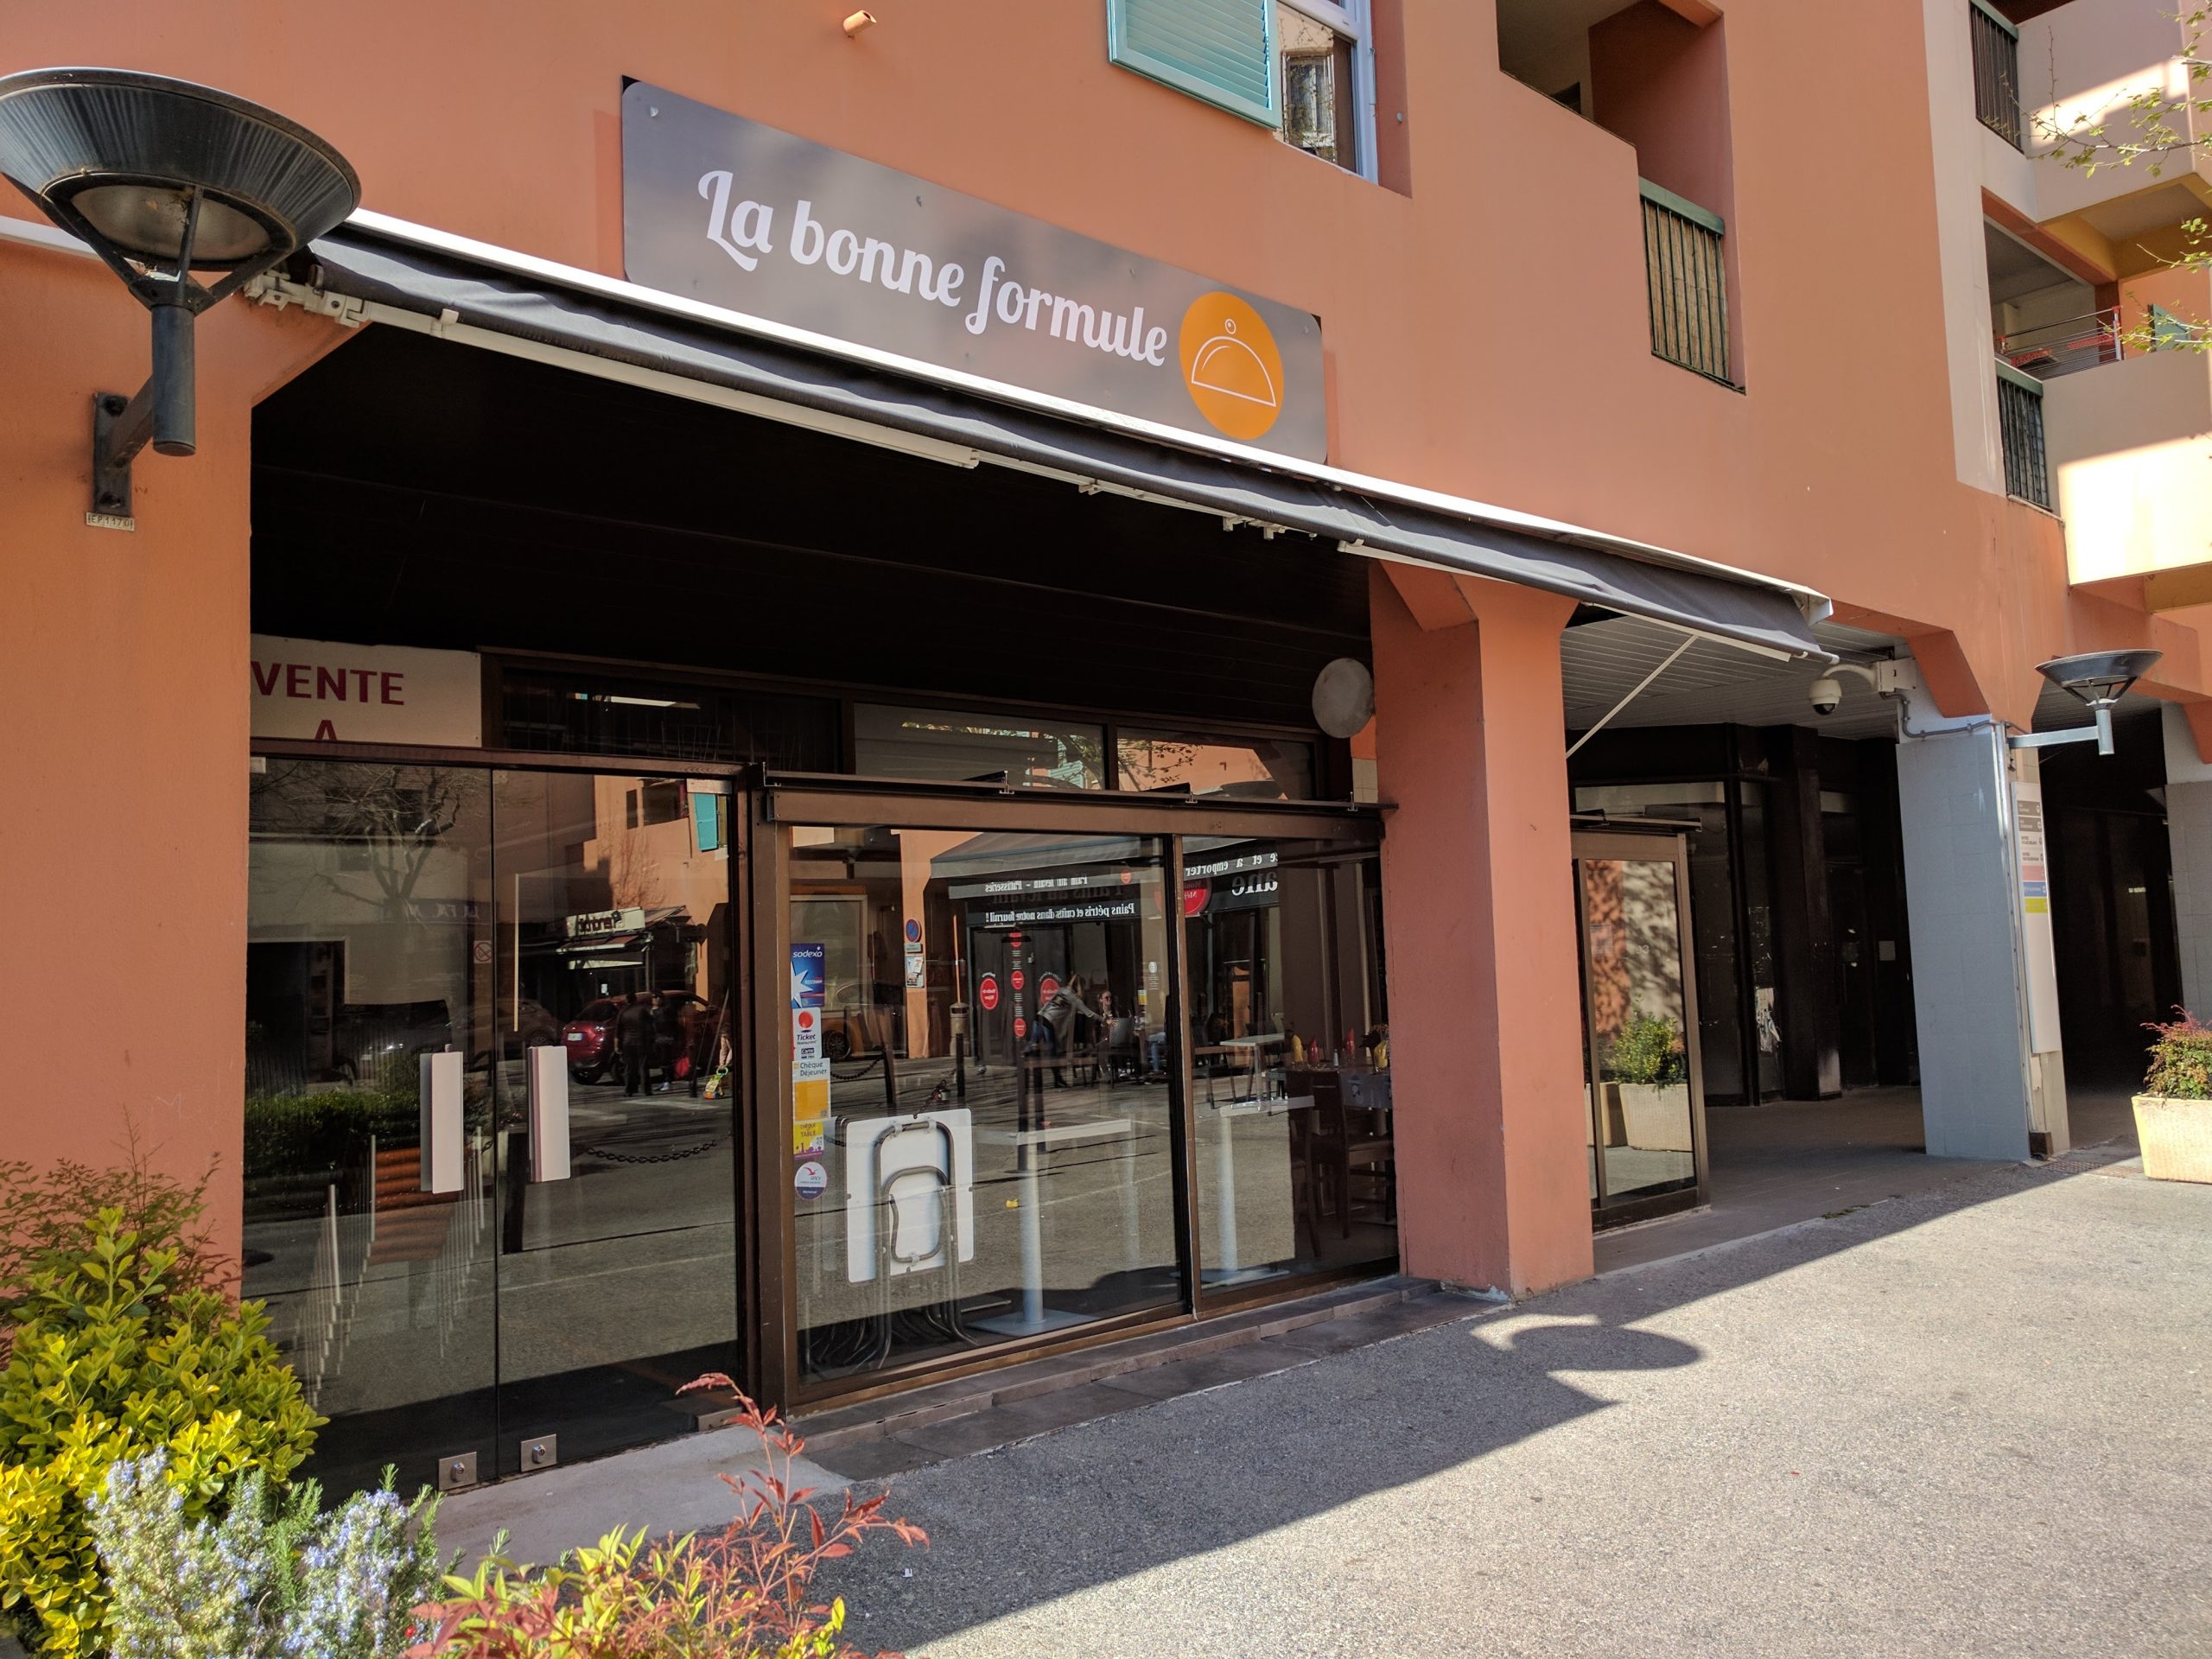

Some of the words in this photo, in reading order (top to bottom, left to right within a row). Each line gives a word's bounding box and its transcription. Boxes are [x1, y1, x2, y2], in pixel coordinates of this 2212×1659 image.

[698, 170, 773, 271] La
[790, 200, 964, 307] bonne
[965, 256, 1167, 366] formule
[251, 660, 404, 705] VENTE
[793, 947, 823, 957] sodexo
